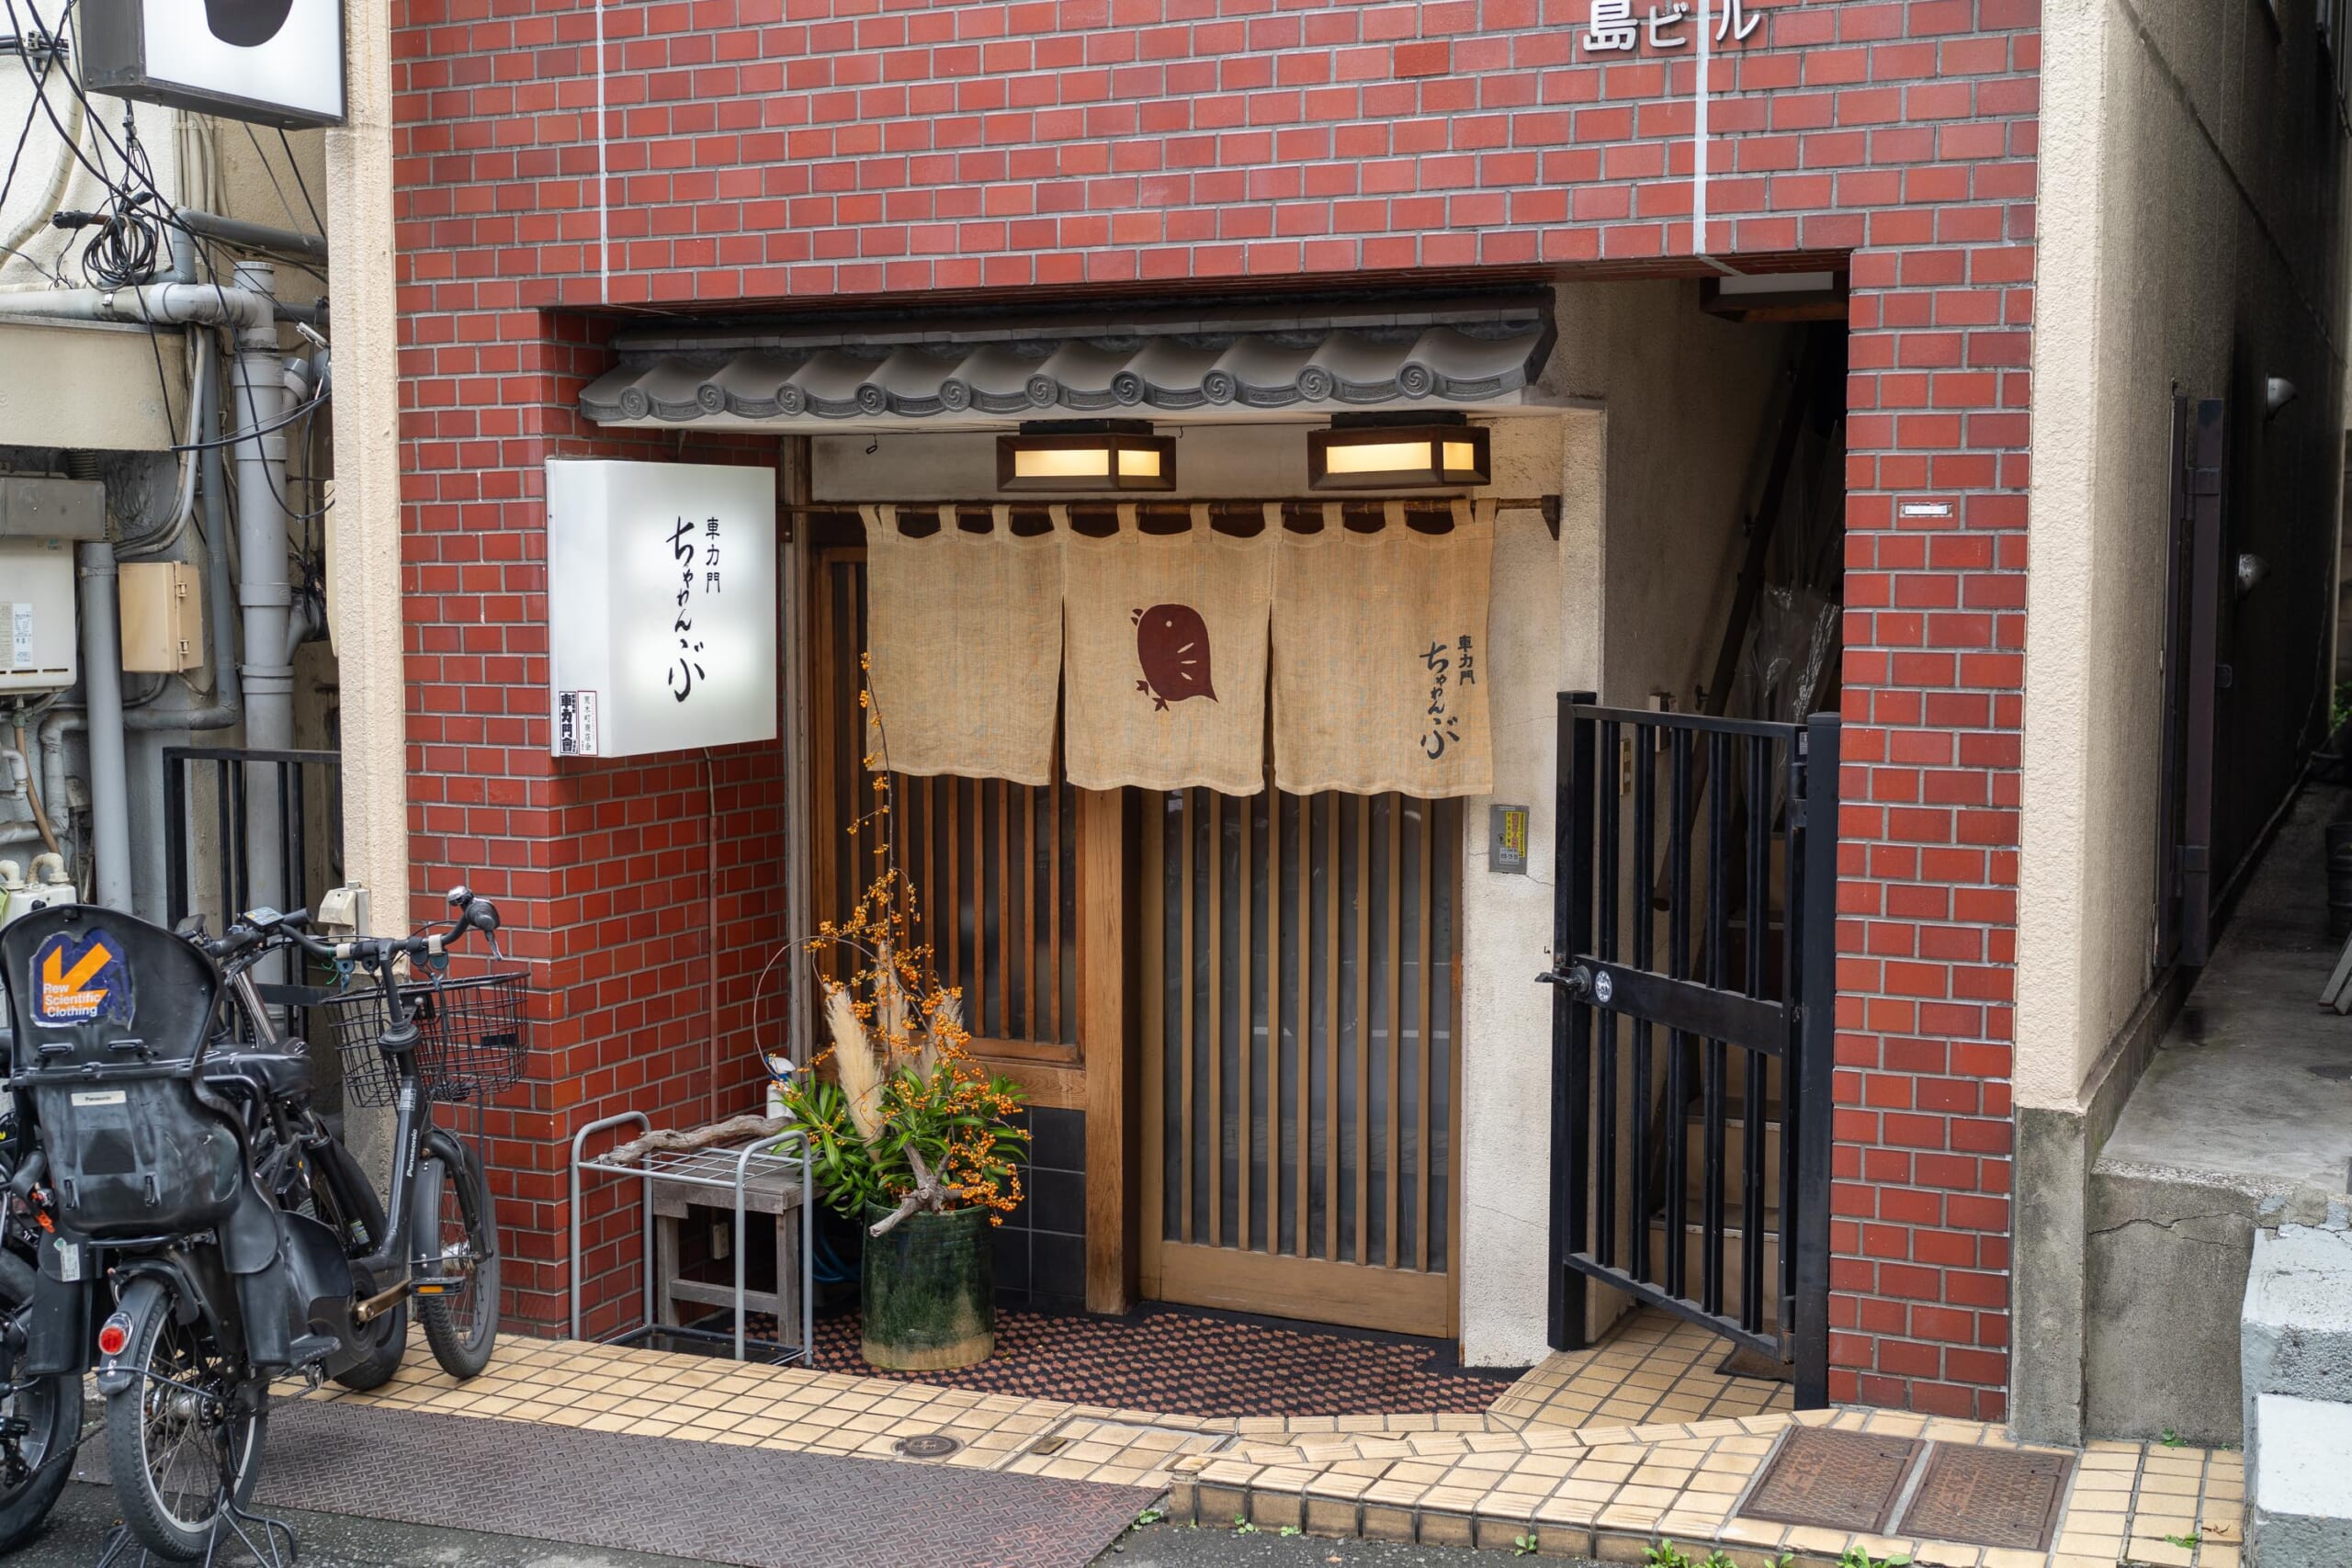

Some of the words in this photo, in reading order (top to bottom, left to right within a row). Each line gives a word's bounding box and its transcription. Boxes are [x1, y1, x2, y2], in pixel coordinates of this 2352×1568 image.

[1583, 0, 1760, 51] 島ビル
[706, 516, 720, 593] 車力門
[665, 515, 706, 703] ちゃわんぶ
[1457, 635, 1476, 686] 車力門
[1419, 641, 1461, 760] ちゃわんぶ
[43, 983, 69, 993] Rew
[45, 993, 102, 1006] Scientific
[47, 1005, 98, 1018] Clothing
[407, 1129, 417, 1177] Panasonic
